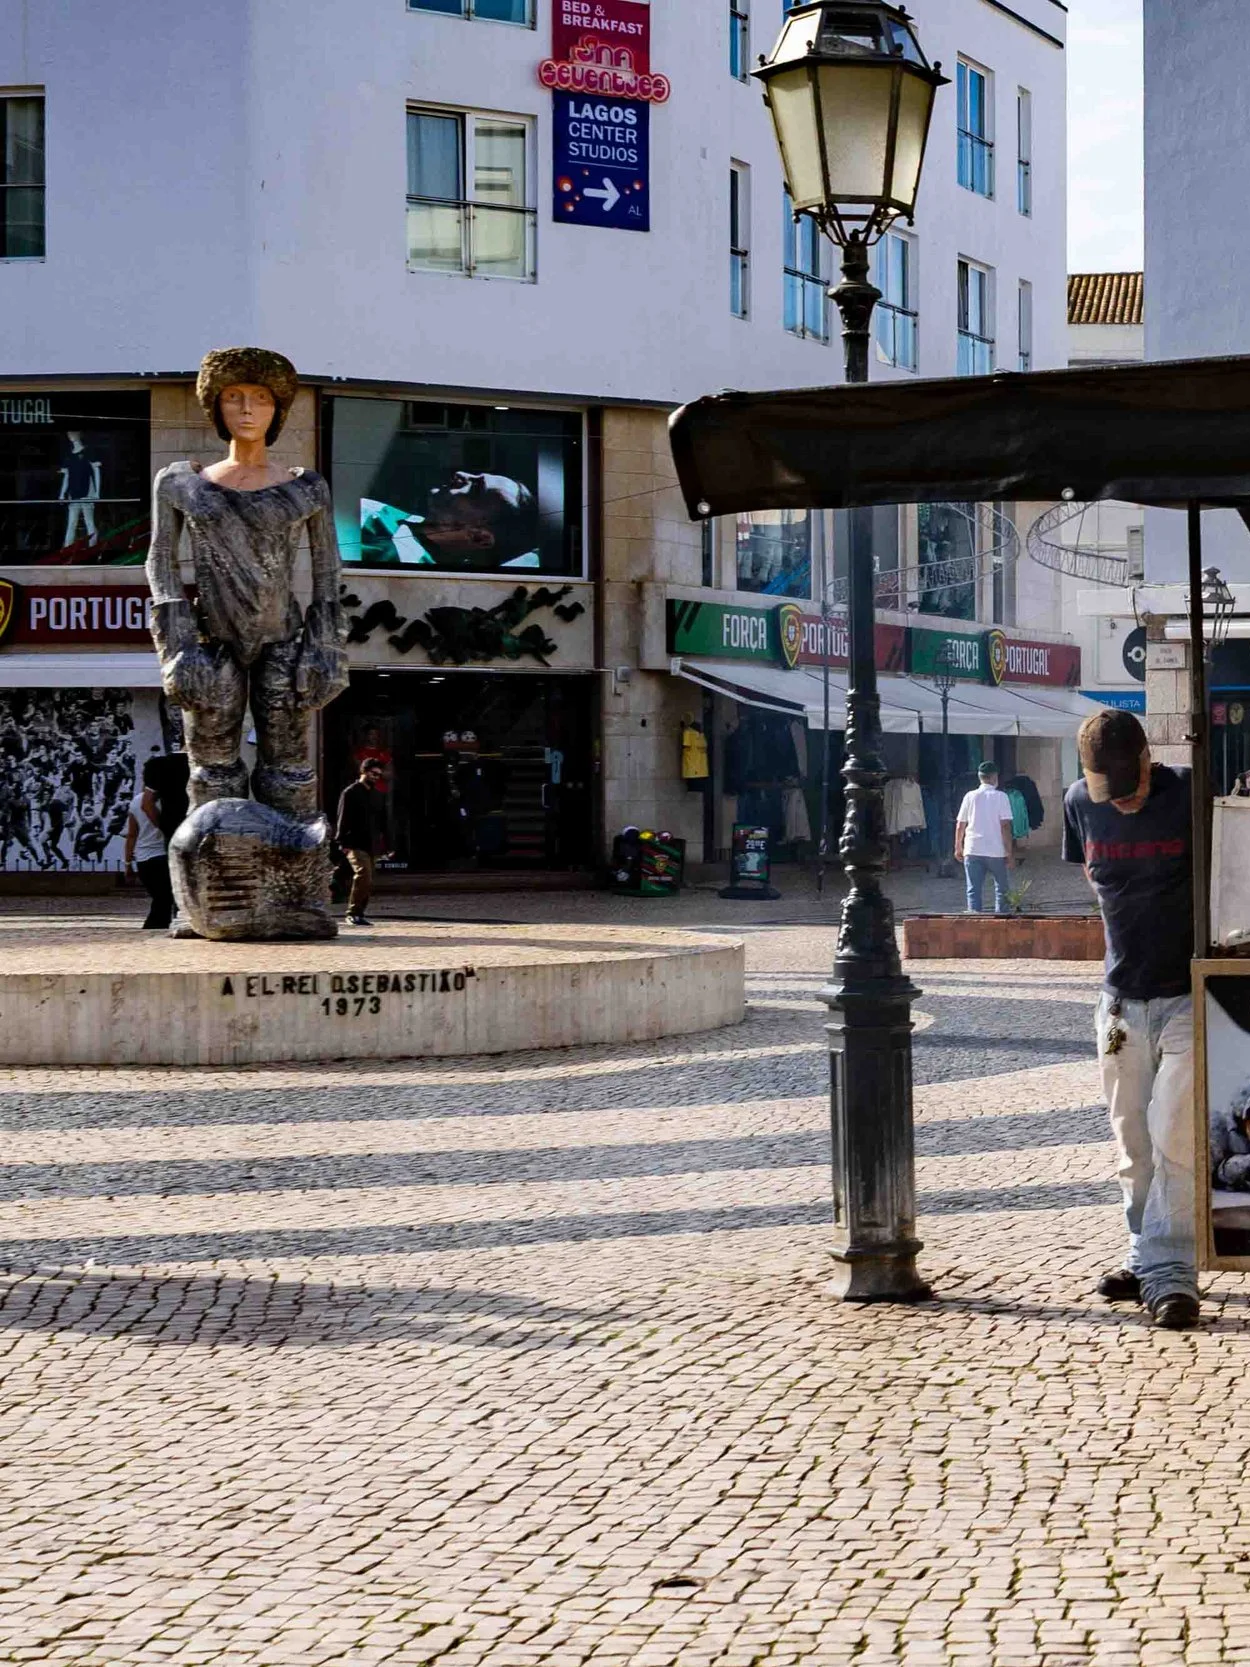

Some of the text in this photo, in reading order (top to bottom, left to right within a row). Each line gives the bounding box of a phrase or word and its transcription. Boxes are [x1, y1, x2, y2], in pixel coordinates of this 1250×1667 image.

[562, 0, 605, 16] BED &
[562, 13, 643, 35] BREAKFAST
[569, 100, 638, 125] LAGOS
[568, 121, 638, 145] CENTER
[568, 141, 638, 163] STUDIOS
[628, 205, 643, 216] AL
[722, 613, 767, 653] FORÇA
[1004, 645, 1050, 676] PORTUGAL
[221, 976, 235, 995] A
[321, 996, 382, 1016] 1973
